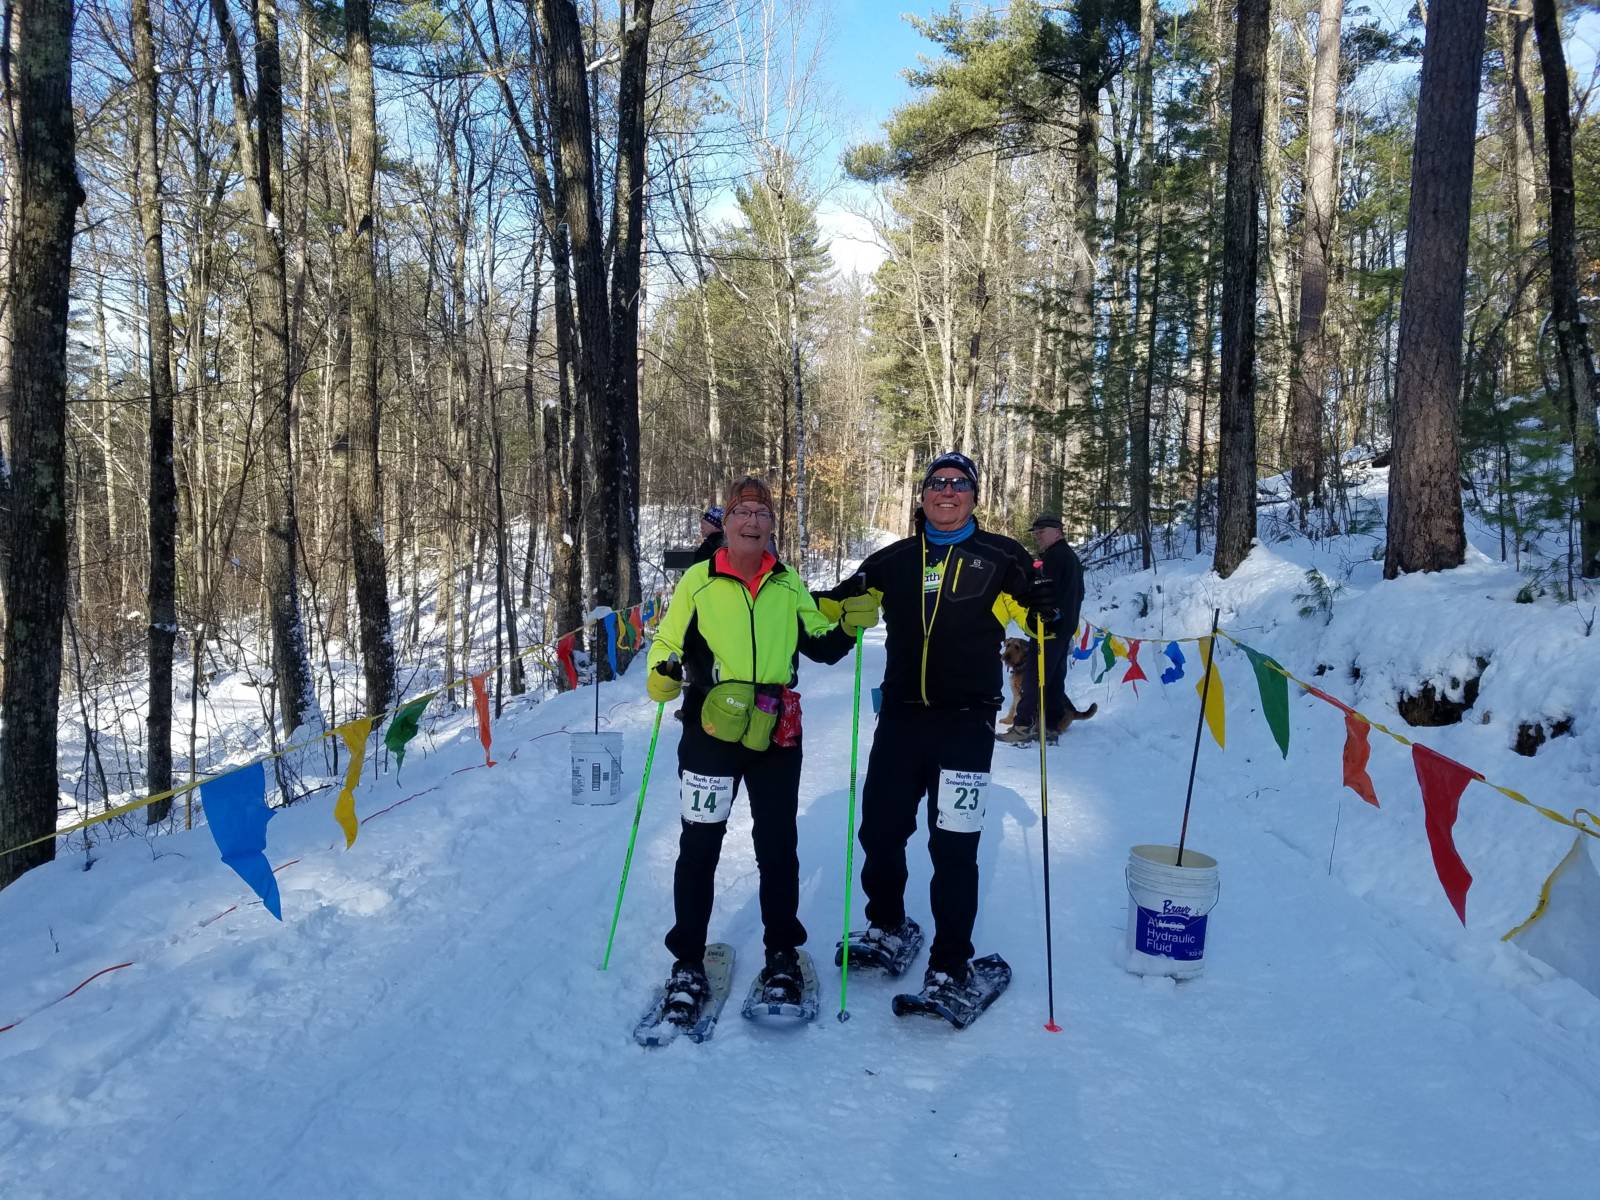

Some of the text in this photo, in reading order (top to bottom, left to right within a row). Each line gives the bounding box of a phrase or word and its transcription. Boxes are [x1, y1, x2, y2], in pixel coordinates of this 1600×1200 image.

[693, 774, 708, 783] North
[945, 777, 973, 787] Snowshoe
[955, 772, 972, 780] North
[686, 778, 709, 790] Snowshoe
[691, 789, 717, 814] 14
[954, 786, 980, 811] 23
[1162, 899, 1192, 915] Bravo
[1147, 927, 1196, 944] Hydraulic
[1146, 938, 1172, 953] Fluid
